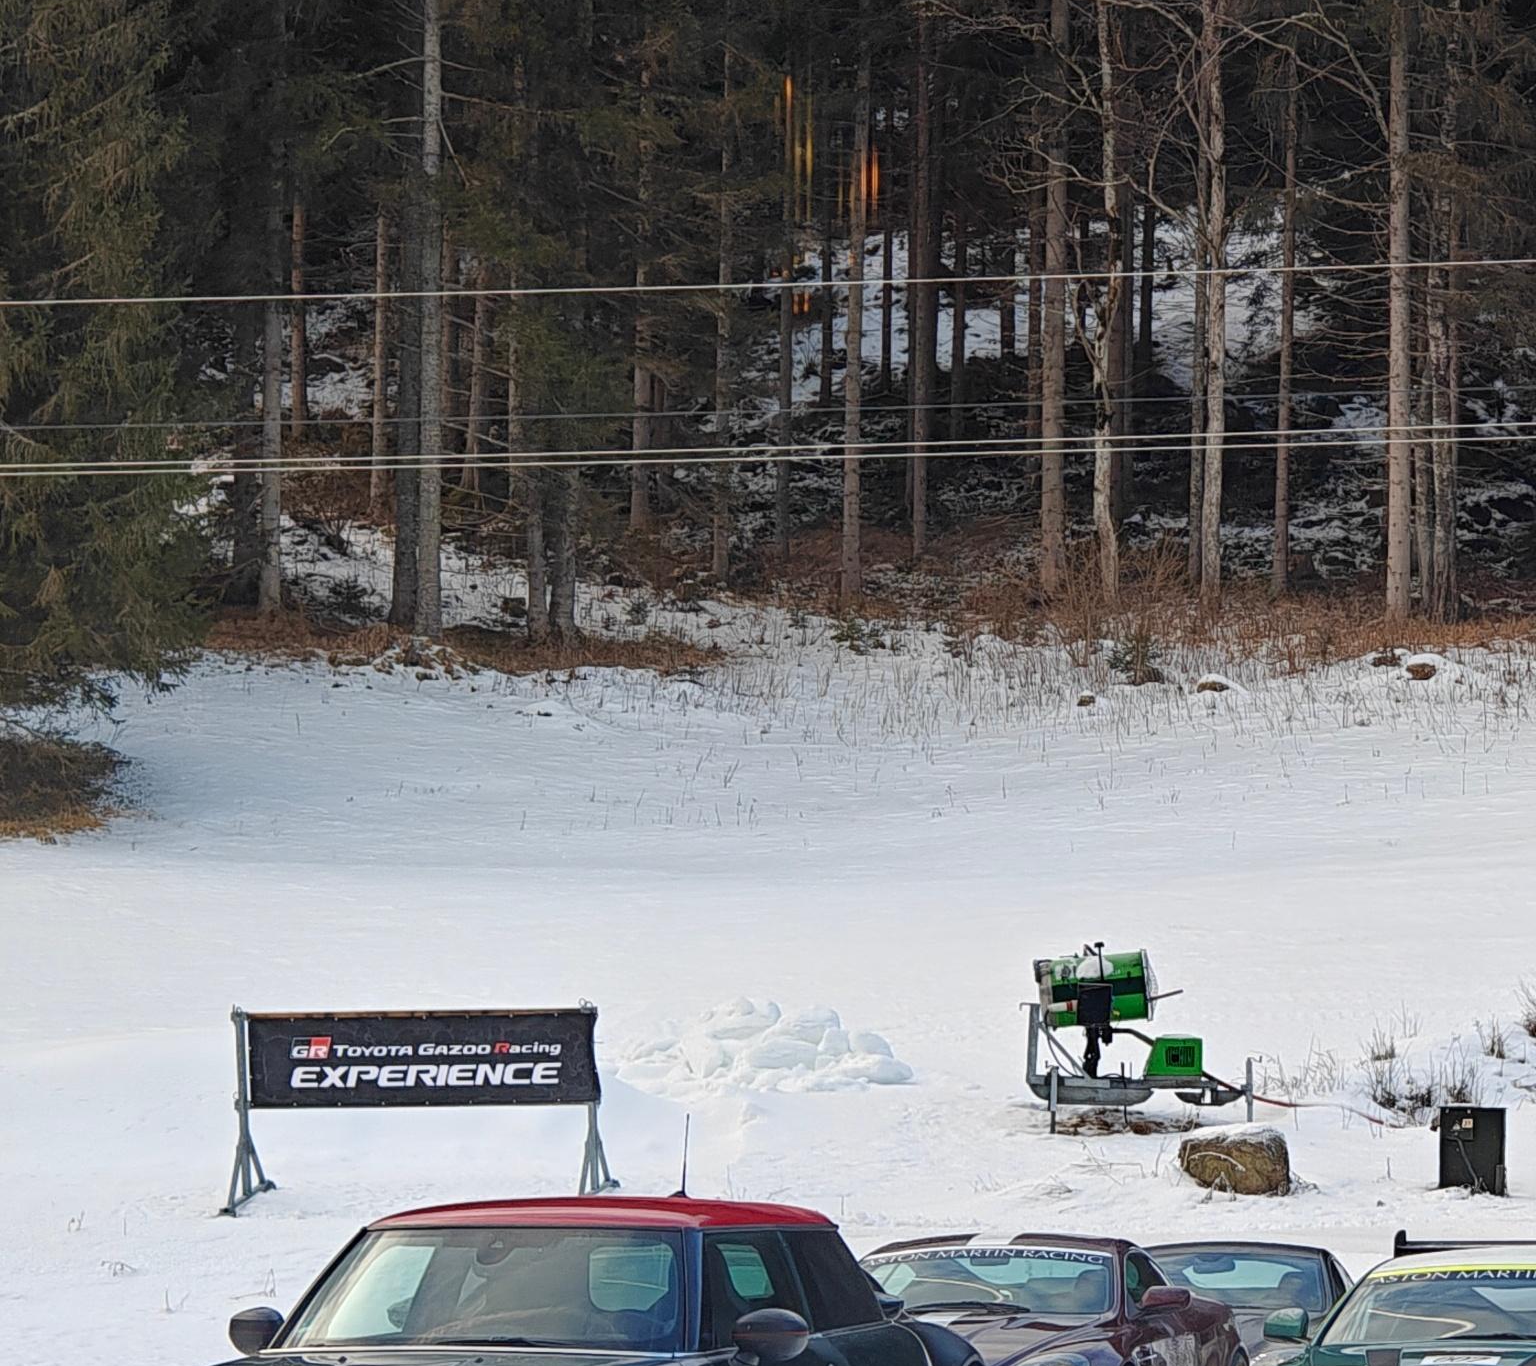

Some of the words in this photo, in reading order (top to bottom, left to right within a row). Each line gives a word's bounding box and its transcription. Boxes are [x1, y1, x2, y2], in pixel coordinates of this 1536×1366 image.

[291, 1045, 328, 1059] GR
[333, 1044, 413, 1057] TOYOTA
[418, 1043, 491, 1055] GAZOO
[494, 1041, 561, 1055] Racing
[290, 1062, 562, 1089] EXPERIENCE
[868, 1251, 931, 1267] ASTON
[935, 1247, 1015, 1259] MARTIN
[1022, 1248, 1104, 1265] RACING
[1370, 1270, 1450, 1285] ASTON
